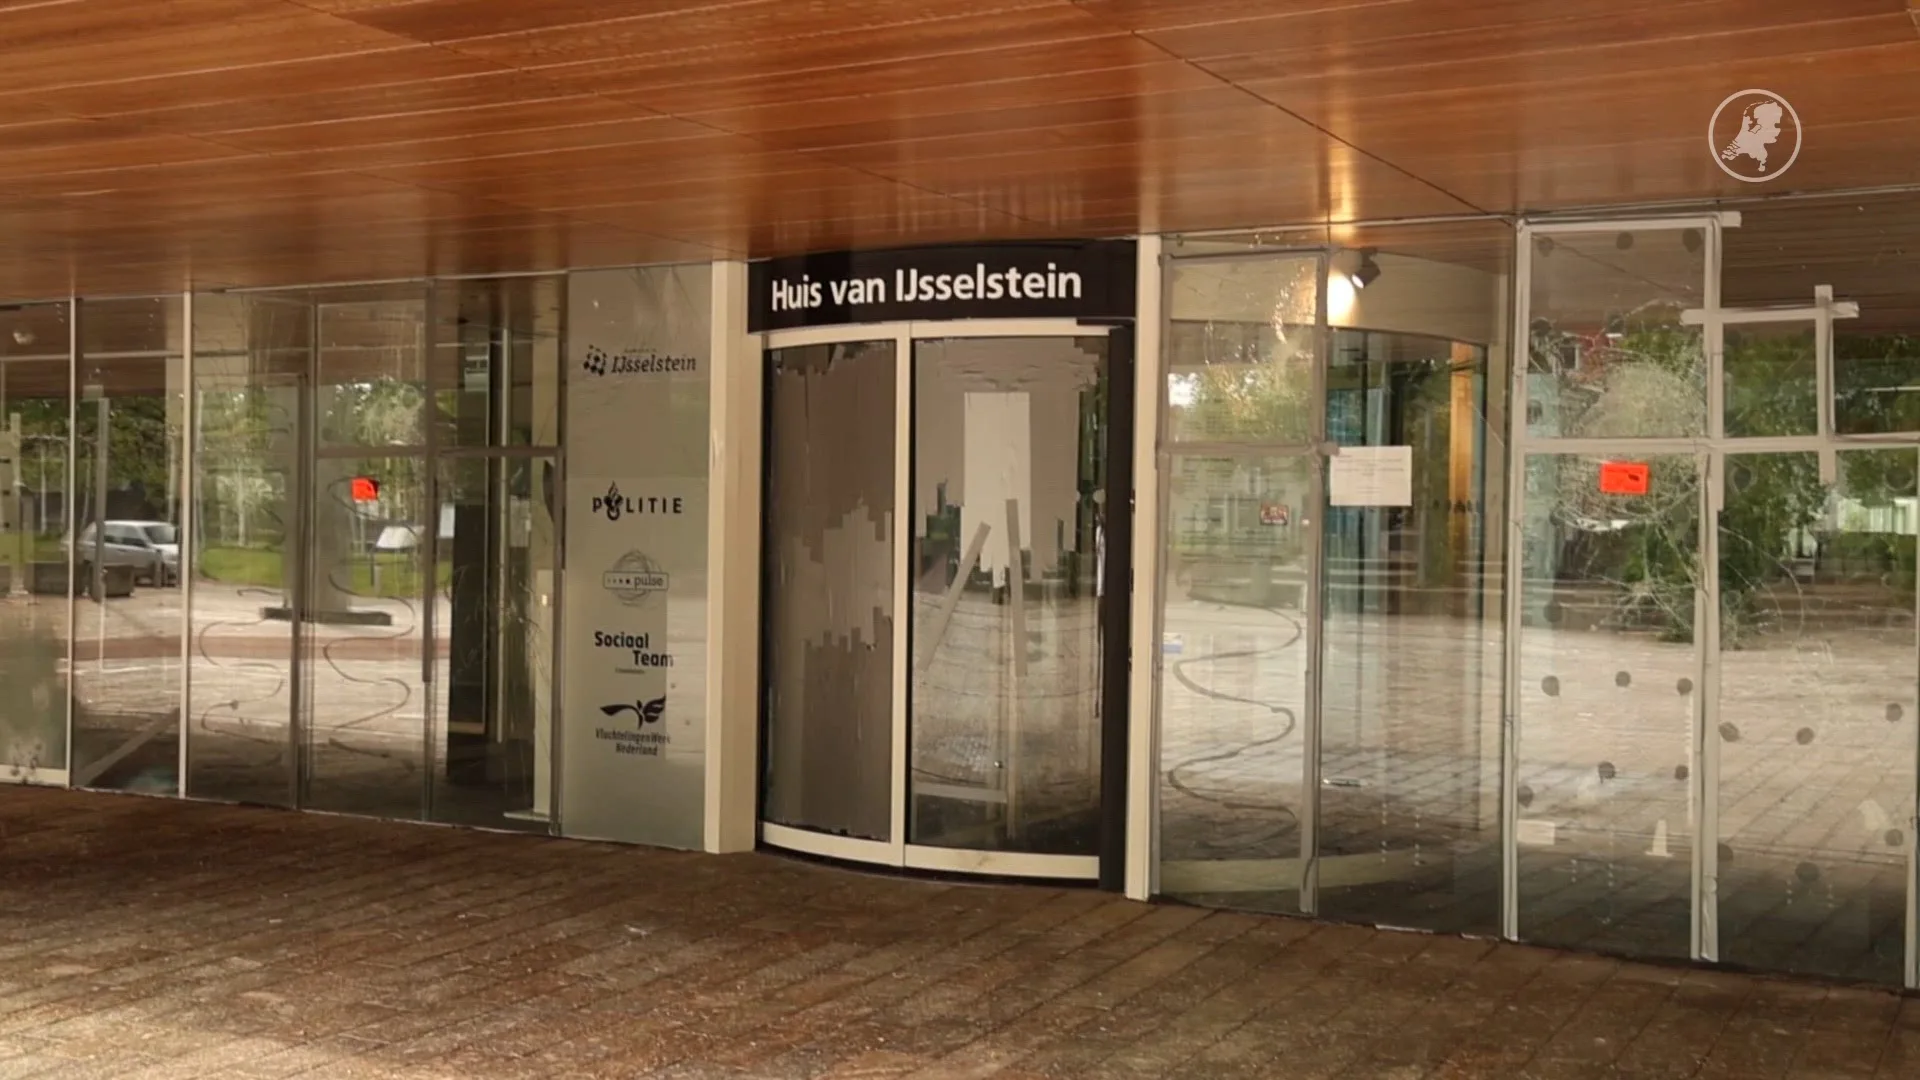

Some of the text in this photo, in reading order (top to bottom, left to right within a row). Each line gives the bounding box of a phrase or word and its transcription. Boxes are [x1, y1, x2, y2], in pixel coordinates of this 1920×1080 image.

[772, 262, 1082, 311] Huis van IJsselstein
[611, 354, 697, 374] IJsselstein
[634, 573, 664, 590] pulse
[594, 631, 649, 649] Sociaal
[632, 650, 674, 667] Team
